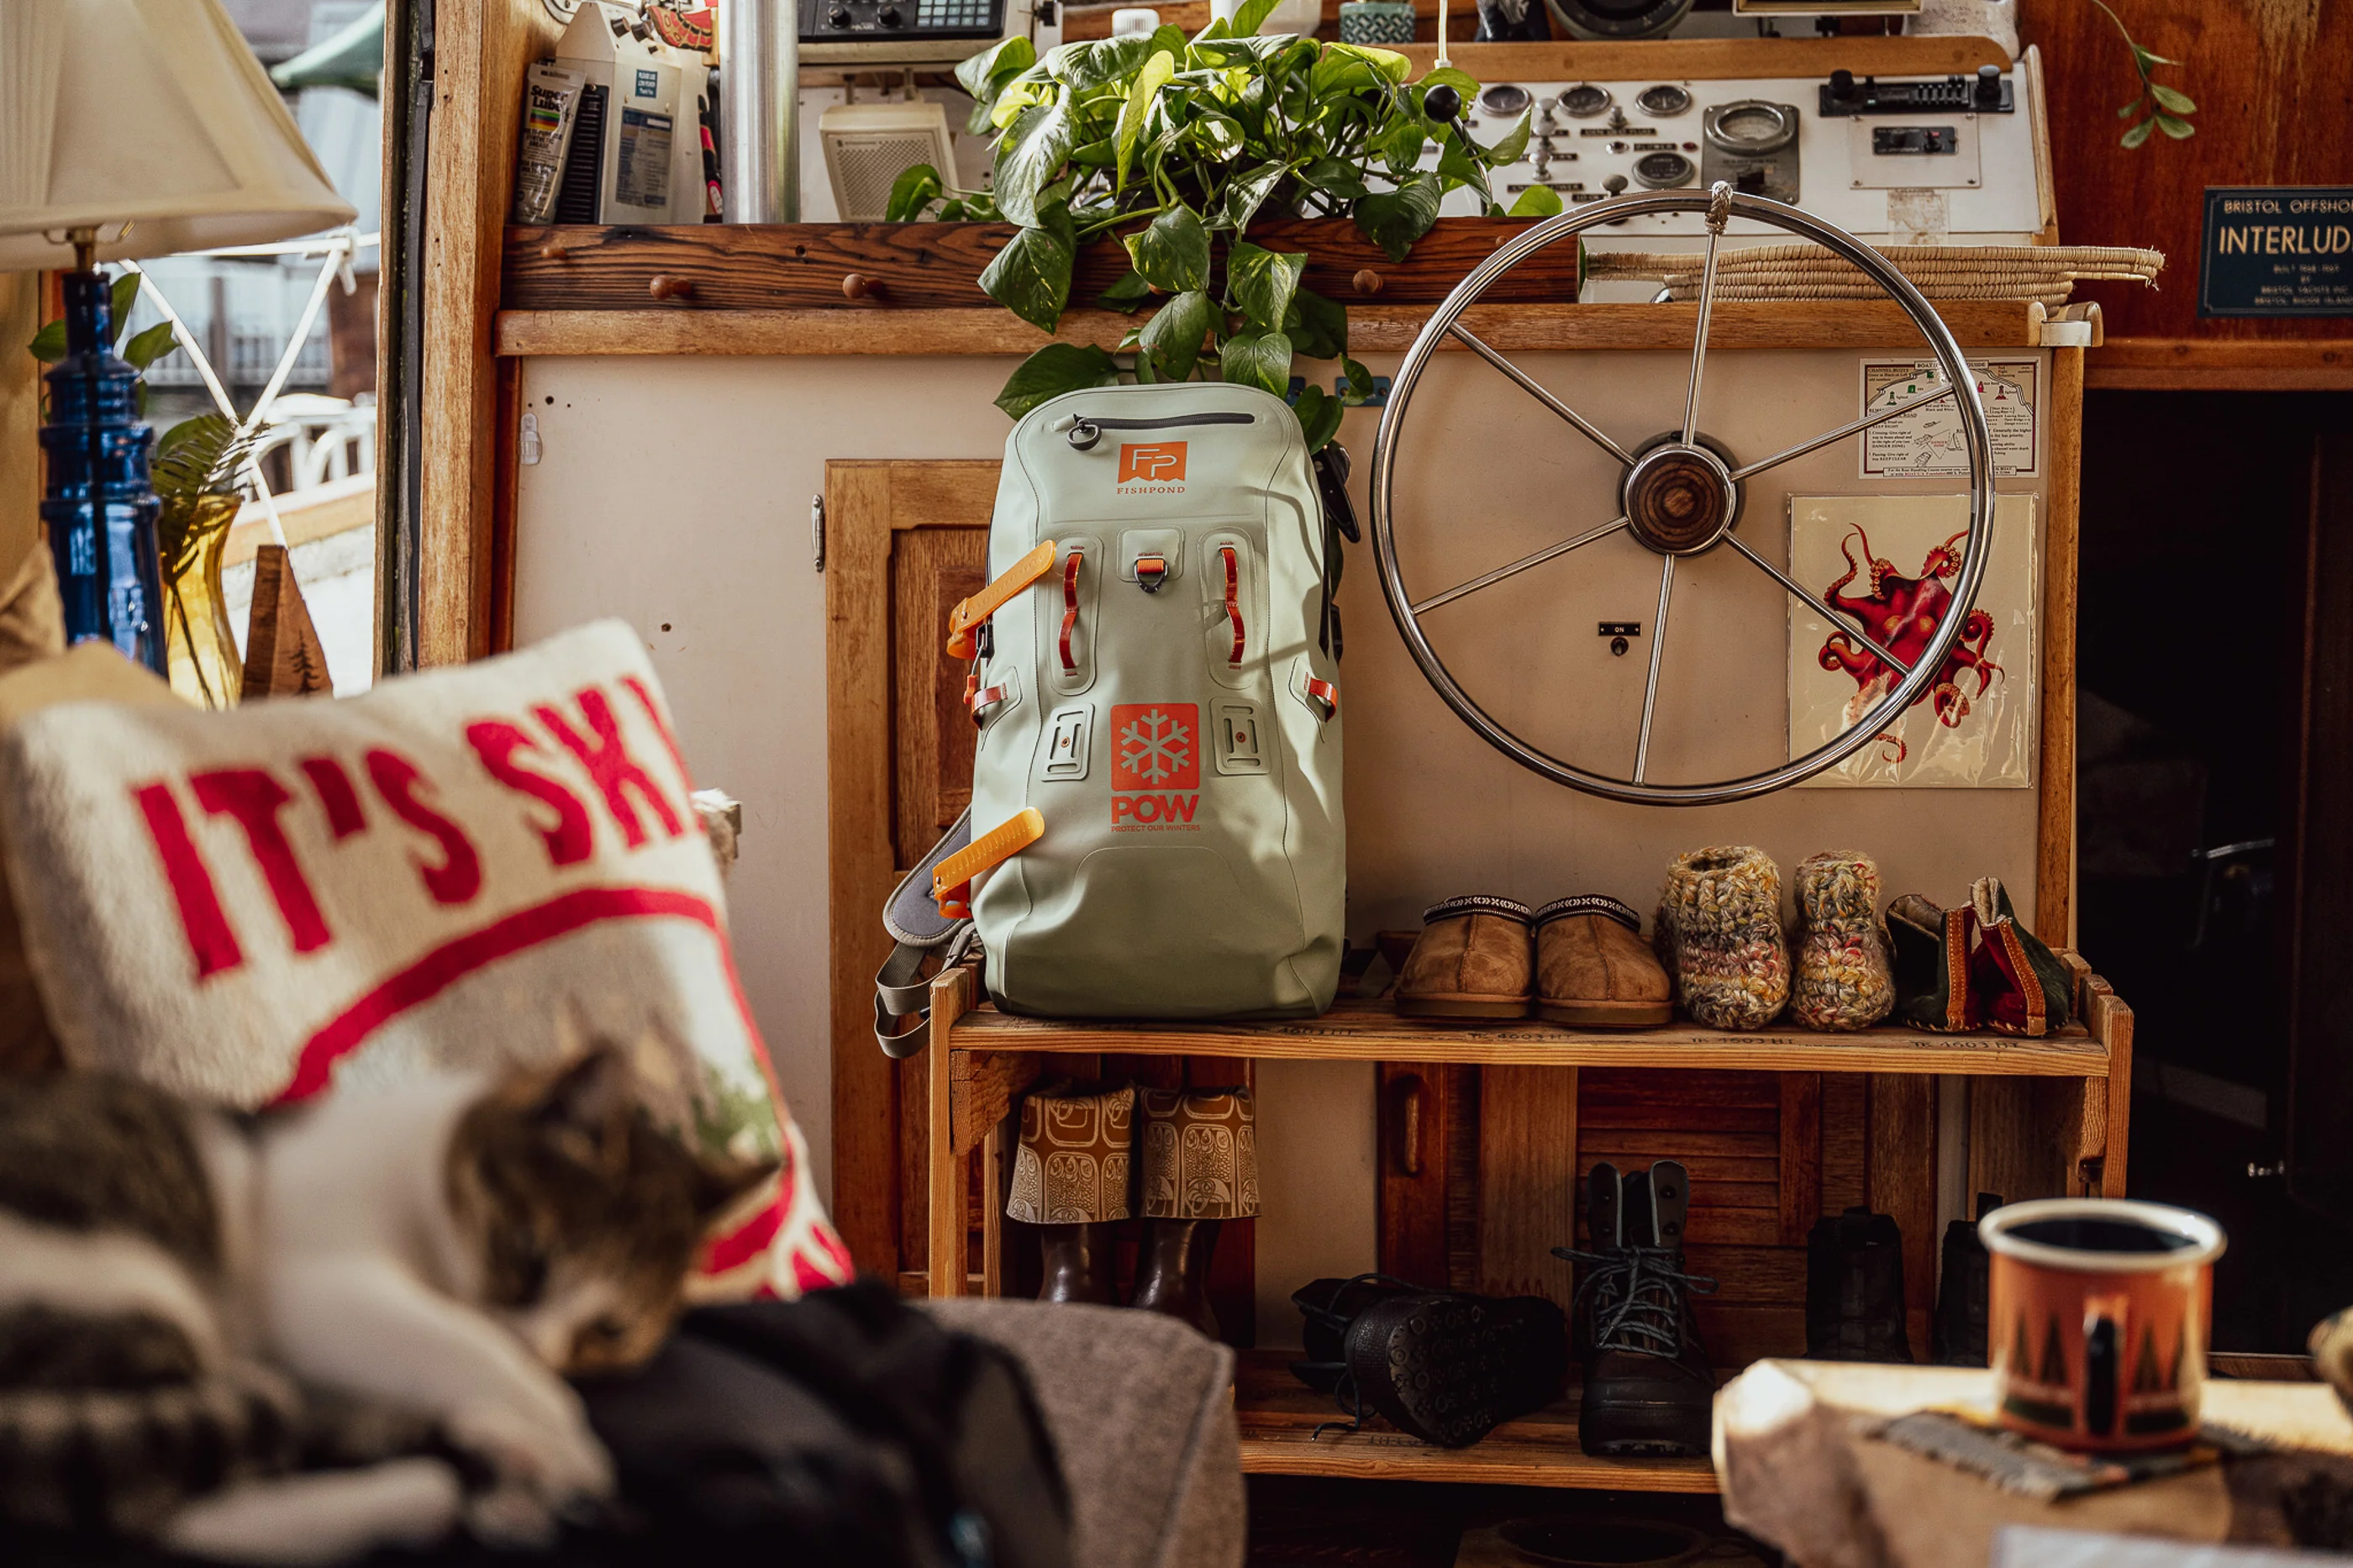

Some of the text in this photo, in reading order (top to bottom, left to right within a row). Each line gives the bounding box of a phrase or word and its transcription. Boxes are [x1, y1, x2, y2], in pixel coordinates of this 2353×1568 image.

[530, 84, 568, 102] Super
[2224, 199, 2353, 214] BRISTOL OFFSHO
[2219, 225, 2353, 254] INTERLUD
[1131, 448, 1177, 478] FP
[1116, 486, 1186, 495] FISHPOND
[1110, 794, 1201, 824] POW
[1110, 824, 1146, 833] PROTECT
[1166, 823, 1201, 832] WINTERS
[132, 746, 483, 987] IT'S
